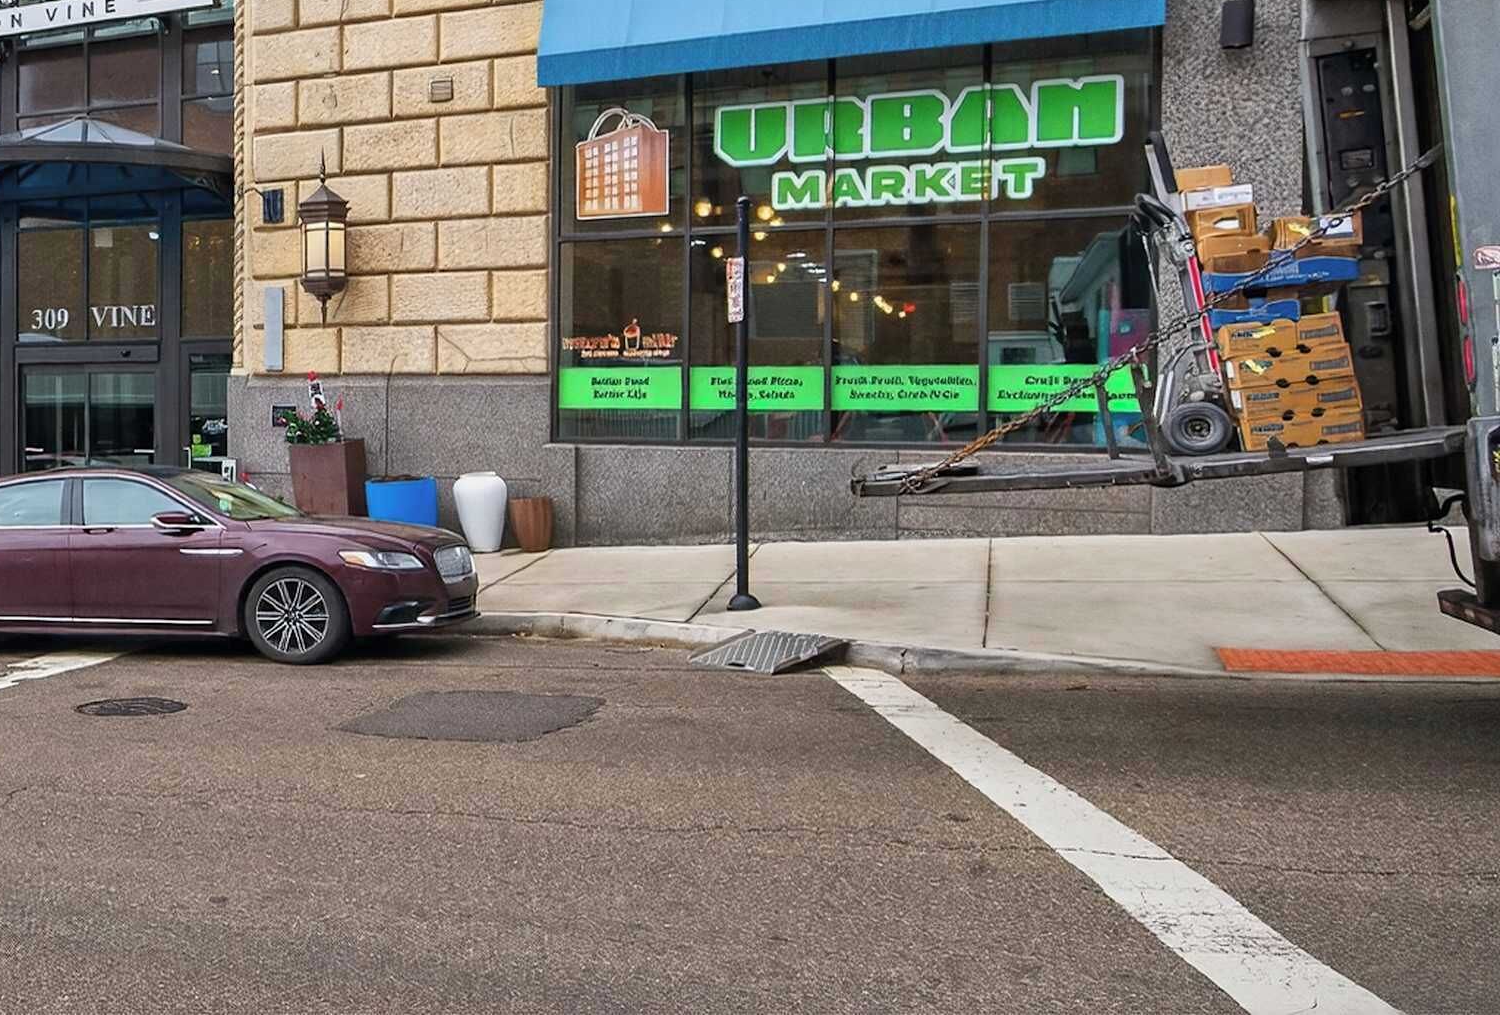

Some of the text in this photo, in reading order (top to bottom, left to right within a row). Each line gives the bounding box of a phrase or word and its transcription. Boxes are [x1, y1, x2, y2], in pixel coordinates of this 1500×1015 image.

[714, 74, 1124, 167] URBAN
[772, 157, 1046, 210] MARKET
[31, 305, 156, 330] 309 VINE
